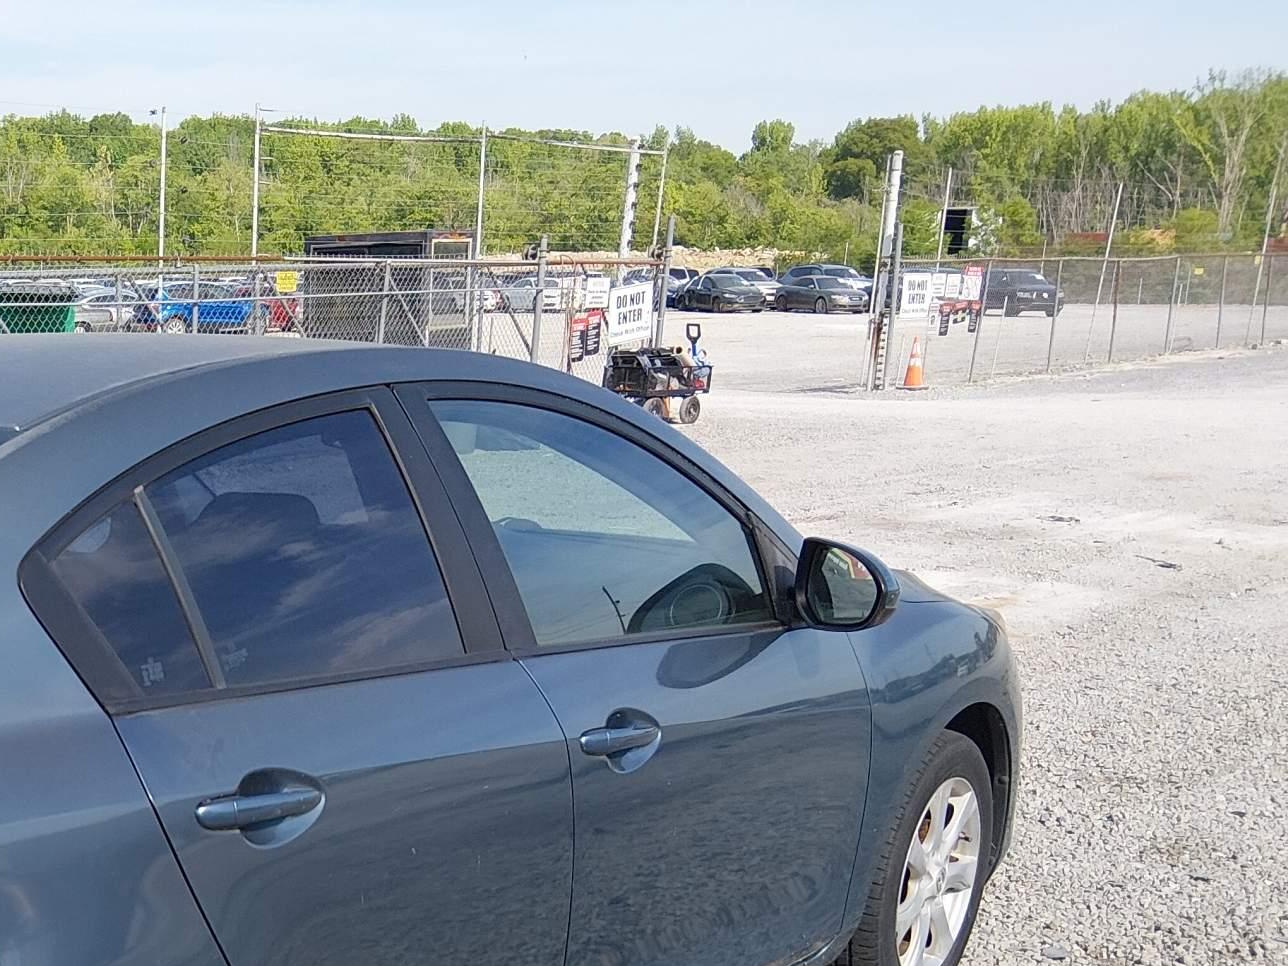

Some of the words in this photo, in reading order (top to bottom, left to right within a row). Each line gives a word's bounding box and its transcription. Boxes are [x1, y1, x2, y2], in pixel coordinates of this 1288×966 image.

[908, 280, 916, 290] DO
[916, 280, 928, 290] NOT
[616, 295, 628, 309] DO
[629, 291, 646, 307] NOT
[908, 294, 925, 304] ENTER
[618, 308, 642, 325] ENTER
